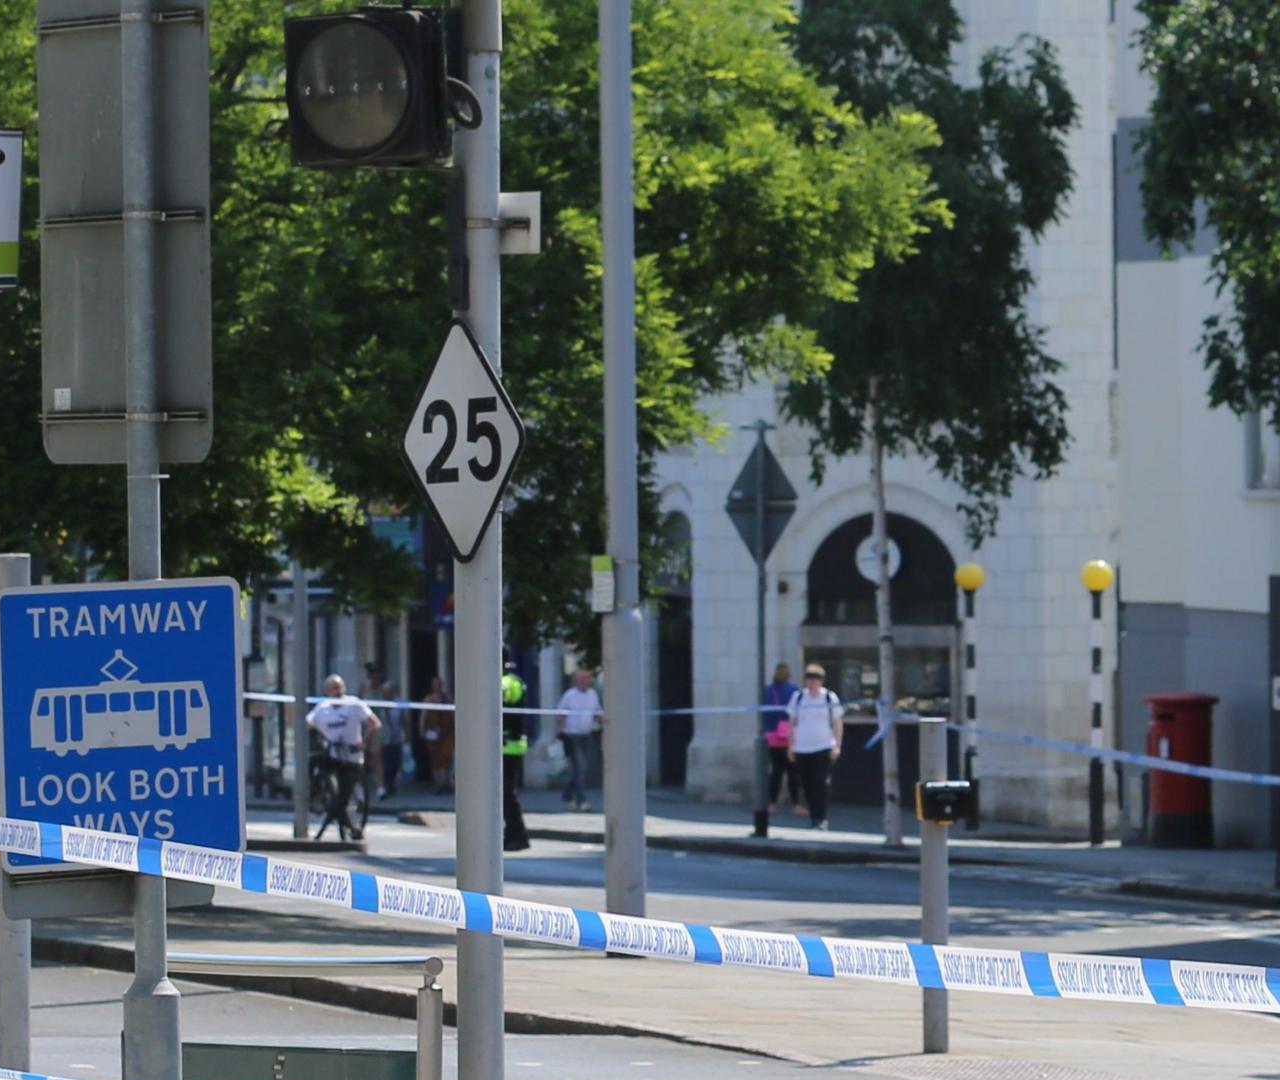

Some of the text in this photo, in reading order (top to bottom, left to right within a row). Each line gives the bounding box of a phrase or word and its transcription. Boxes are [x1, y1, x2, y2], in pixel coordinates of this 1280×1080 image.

[421, 395, 503, 485] 25
[26, 600, 208, 639] TRAMWAY
[18, 770, 115, 808] LOOK
[129, 764, 225, 800] BOTH
